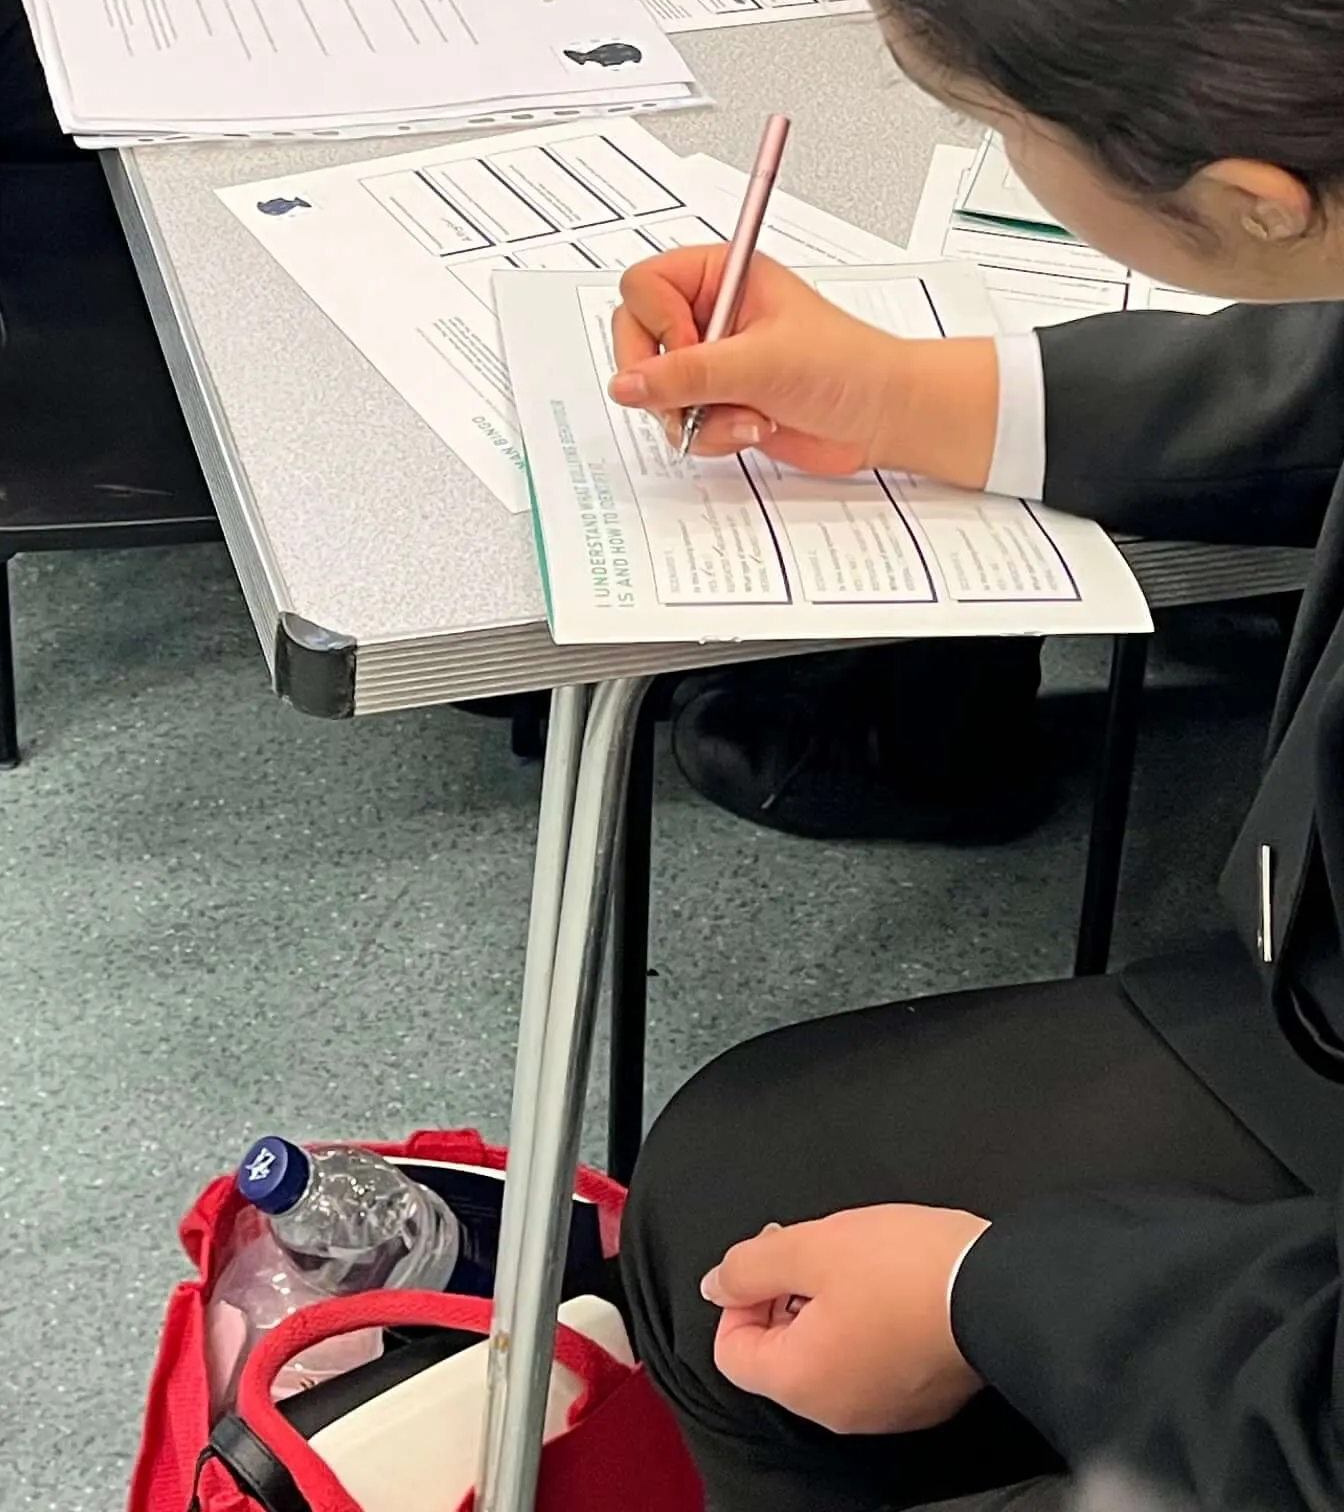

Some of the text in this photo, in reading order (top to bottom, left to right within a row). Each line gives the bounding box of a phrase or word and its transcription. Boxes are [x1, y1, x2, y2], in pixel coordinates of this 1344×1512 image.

[472, 416, 507, 447] BINGO
[573, 486, 593, 511] WHAT
[603, 512, 619, 525] TO
[608, 527, 625, 554] HOW
[582, 513, 610, 598] UNDERSTAND
[613, 558, 633, 589] AND
[618, 592, 634, 608] IS
